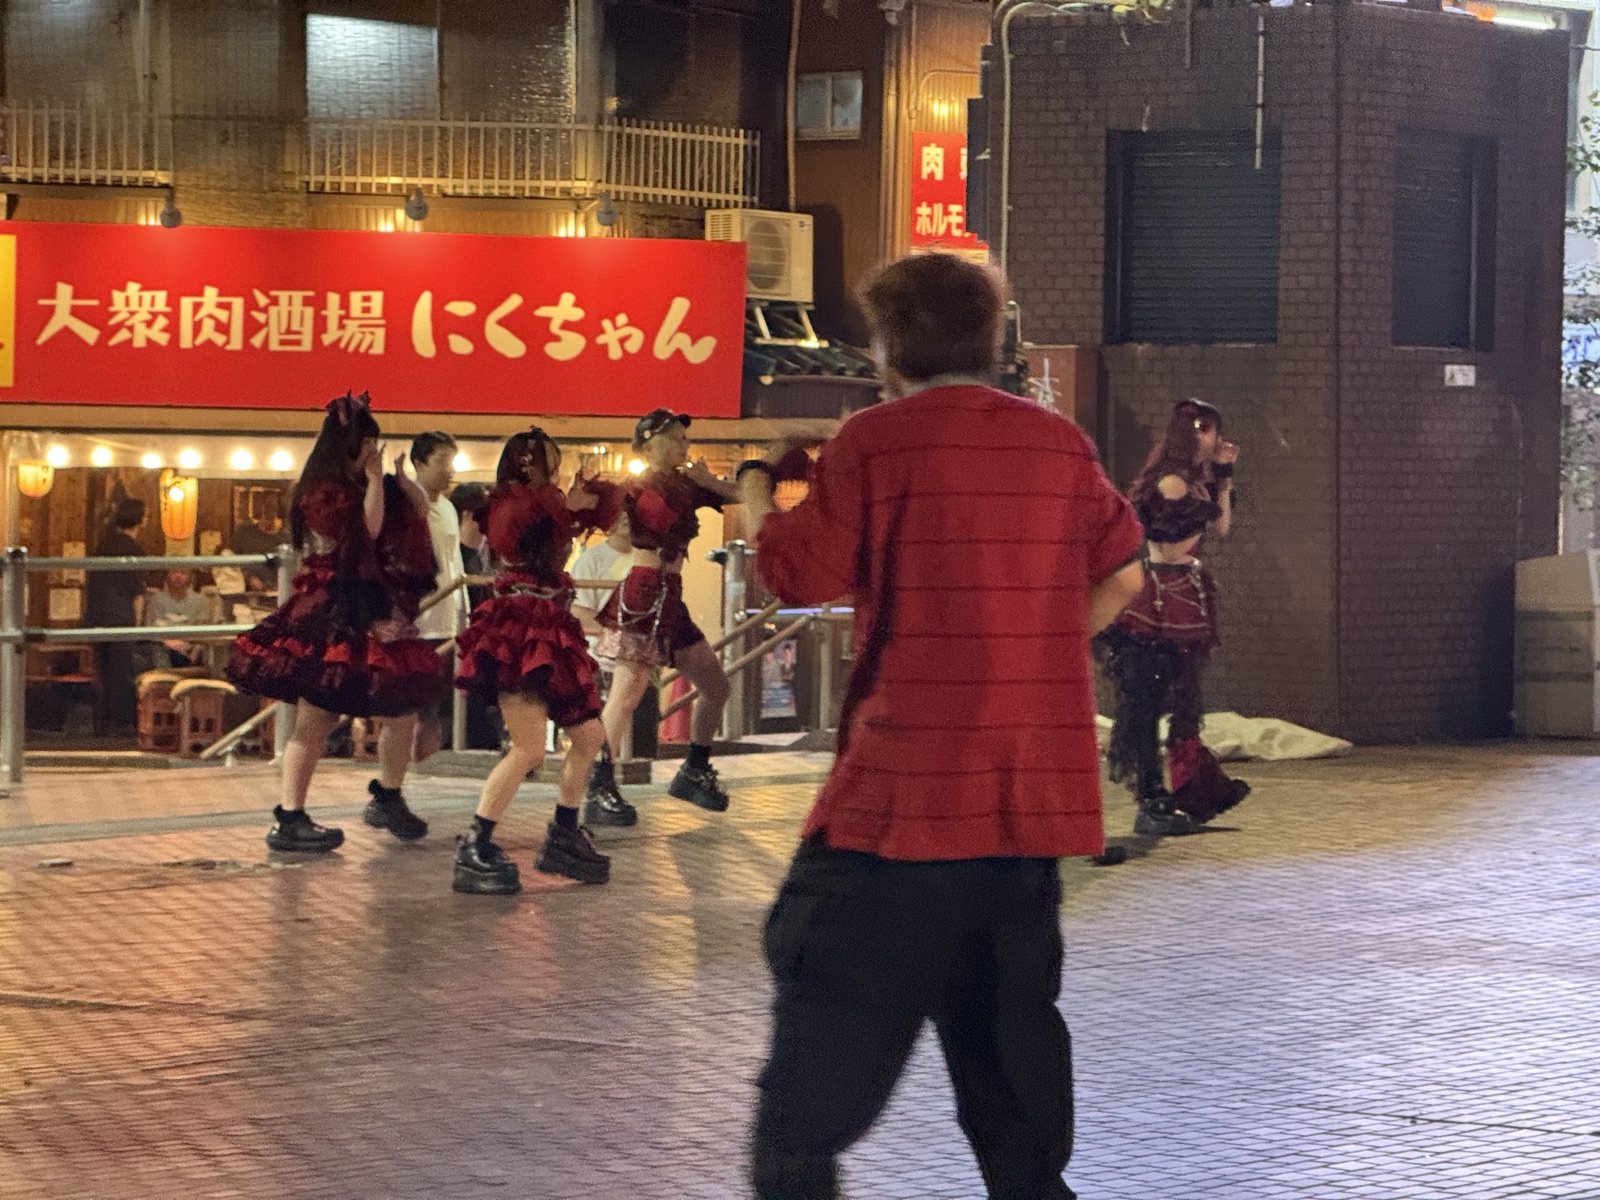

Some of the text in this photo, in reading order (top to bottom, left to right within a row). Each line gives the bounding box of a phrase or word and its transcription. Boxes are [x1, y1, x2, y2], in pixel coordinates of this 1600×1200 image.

[916, 201, 970, 237] ホルモ
[37, 281, 716, 363] 大衆肉酒場 にくちゃん
